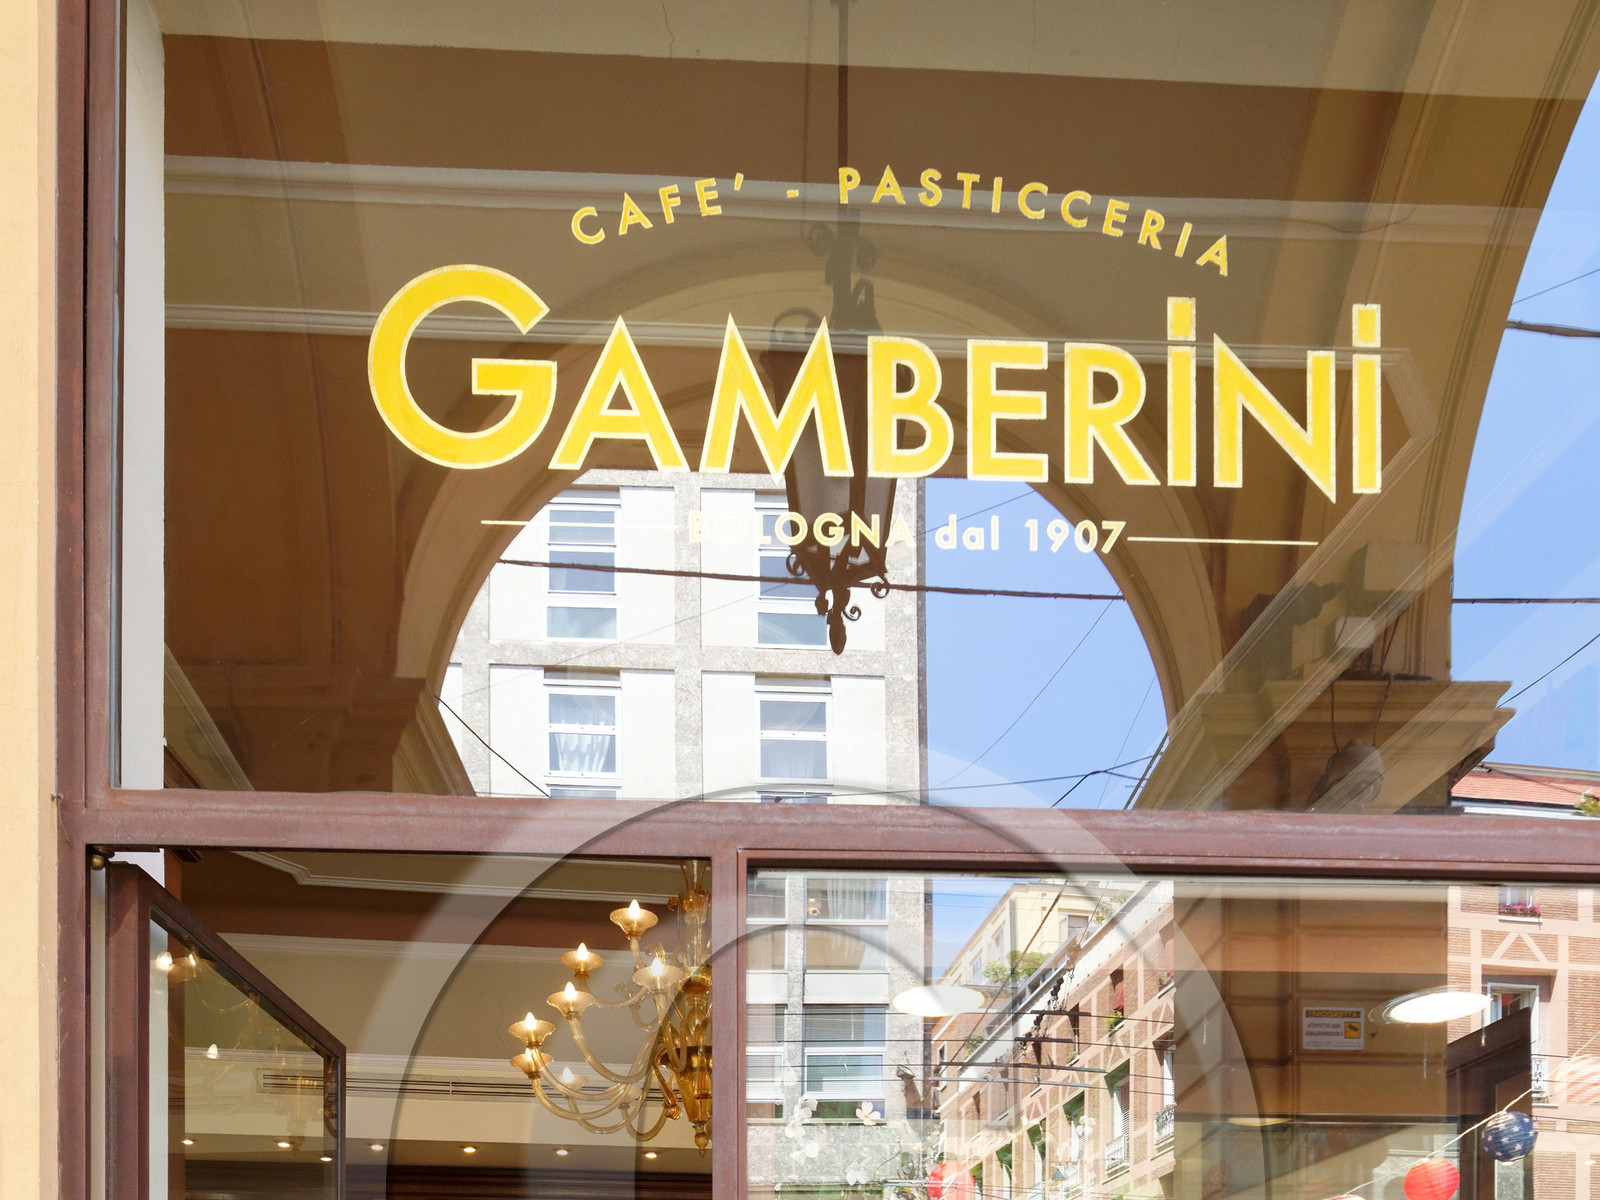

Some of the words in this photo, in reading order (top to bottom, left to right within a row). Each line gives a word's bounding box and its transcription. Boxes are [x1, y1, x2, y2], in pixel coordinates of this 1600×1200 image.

[838, 164, 1230, 277] PASTICCERIA
[688, 511, 915, 549] BOLOGNA
[935, 514, 999, 552] dal
[1024, 519, 1127, 554] 1907
